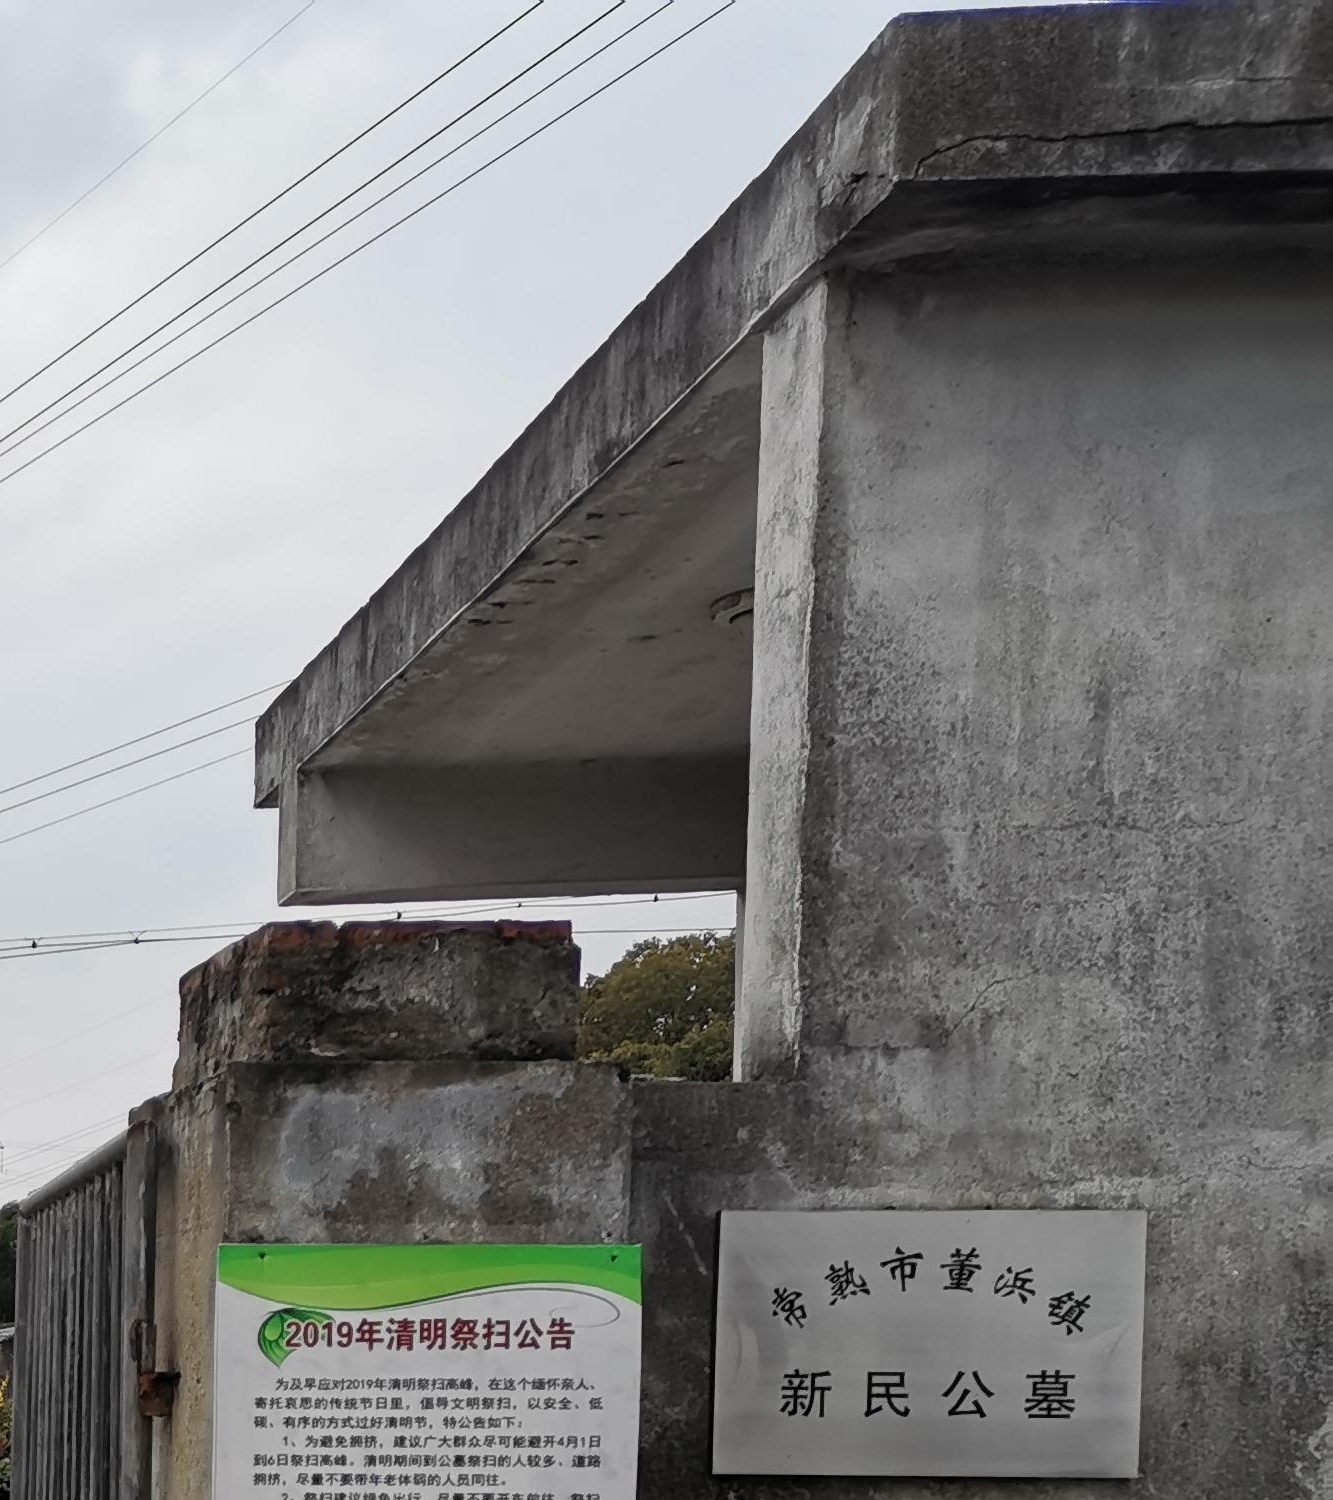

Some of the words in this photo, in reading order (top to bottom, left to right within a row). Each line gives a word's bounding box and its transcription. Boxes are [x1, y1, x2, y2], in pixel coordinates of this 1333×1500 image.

[284, 1317, 575, 1351] 2019年清明祭扫公告
[779, 1369, 1076, 1419] 新民公墓
